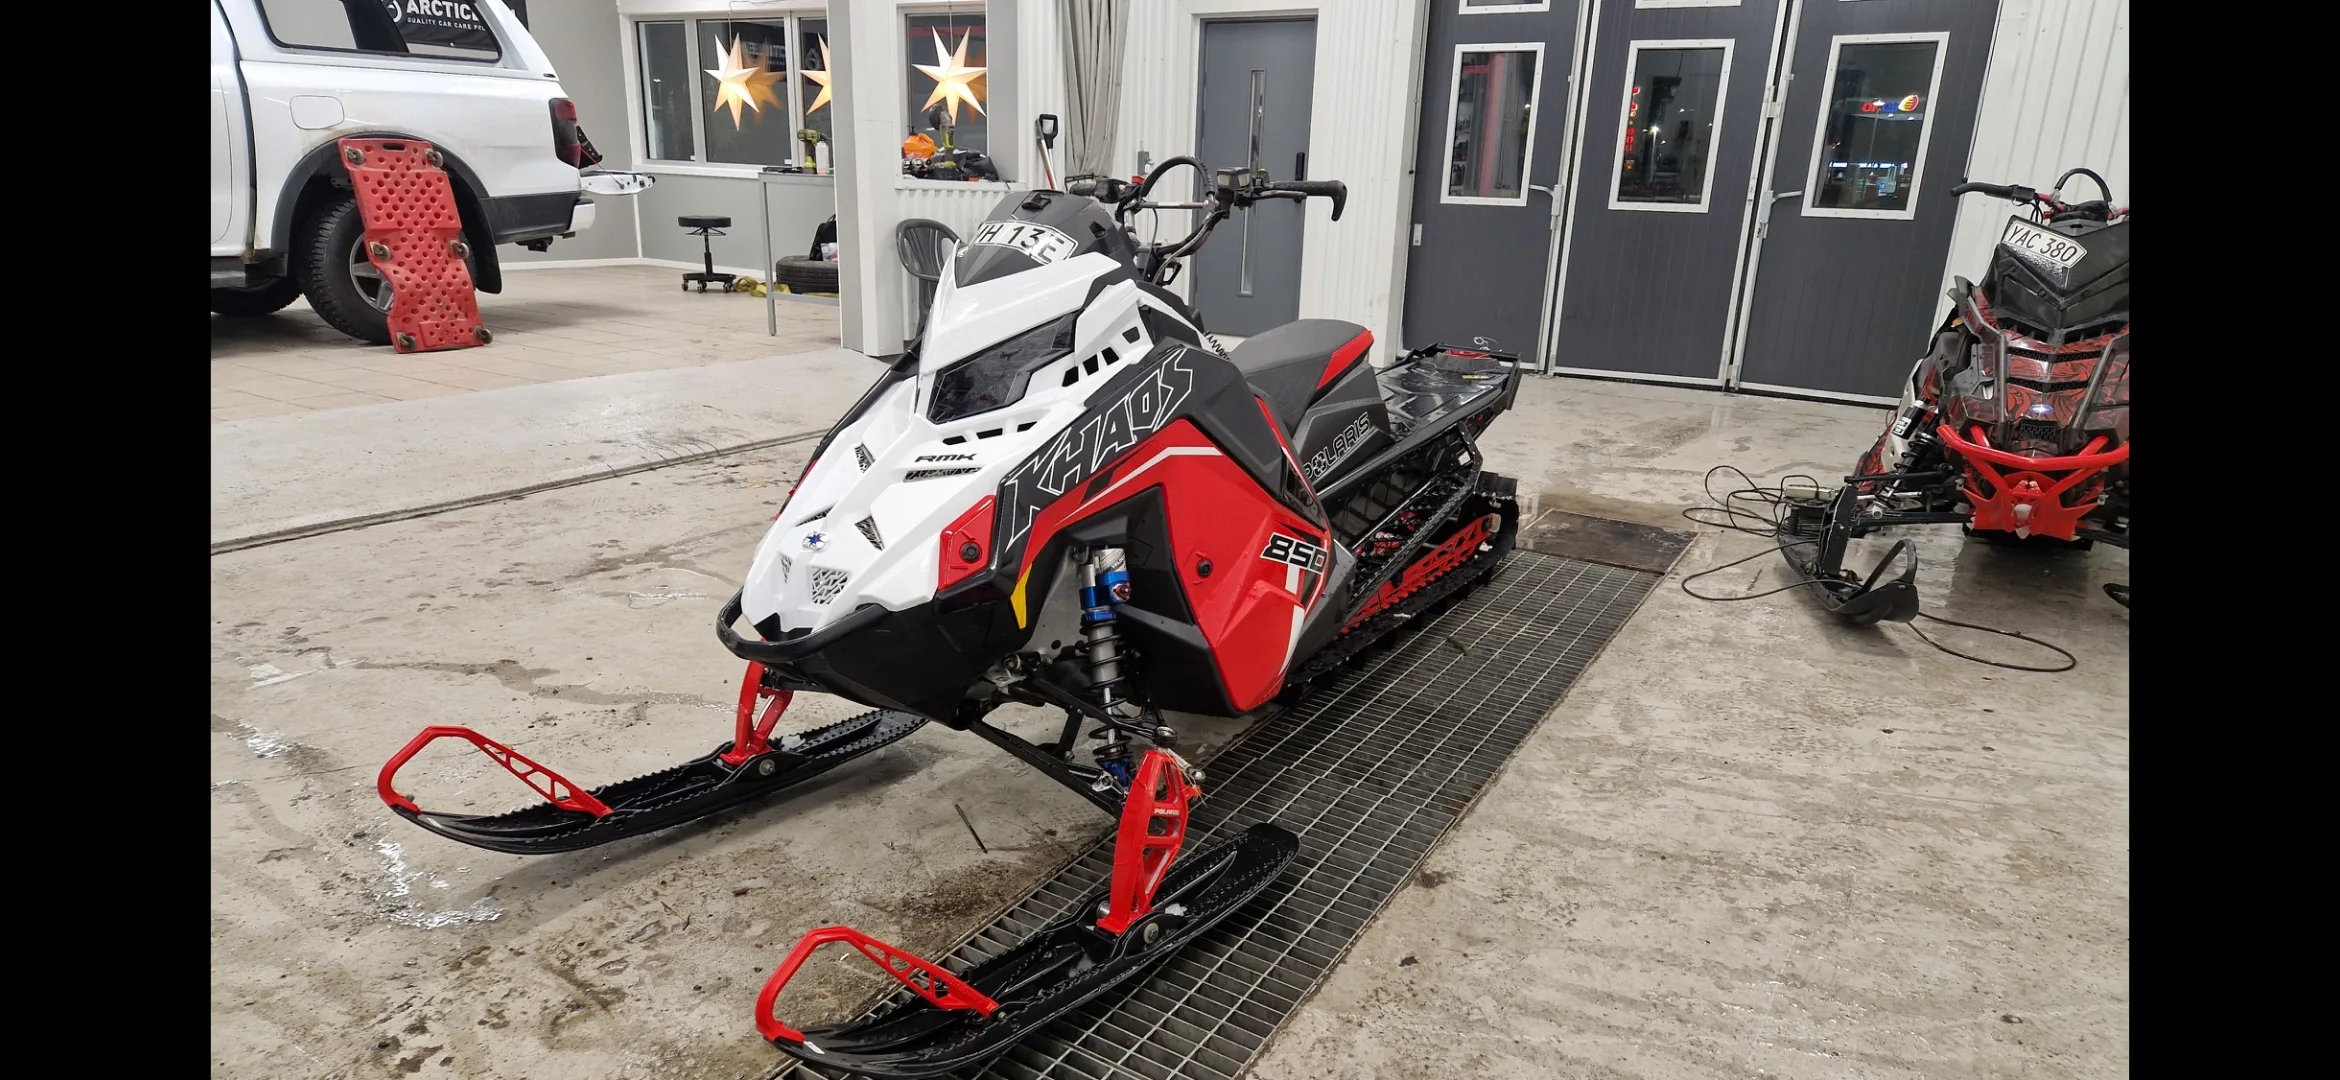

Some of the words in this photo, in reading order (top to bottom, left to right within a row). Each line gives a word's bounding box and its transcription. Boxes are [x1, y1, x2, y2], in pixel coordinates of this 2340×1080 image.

[407, 17, 436, 26] QUALITY
[438, 20, 451, 28] CAR
[454, 21, 471, 30] CARE
[977, 224, 1004, 243] H
[2008, 225, 2042, 249] YAC
[2040, 237, 2078, 263] 380
[914, 453, 977, 463] RMK
[1004, 346, 1194, 554] KHAOS
[1259, 531, 1329, 575] 850
